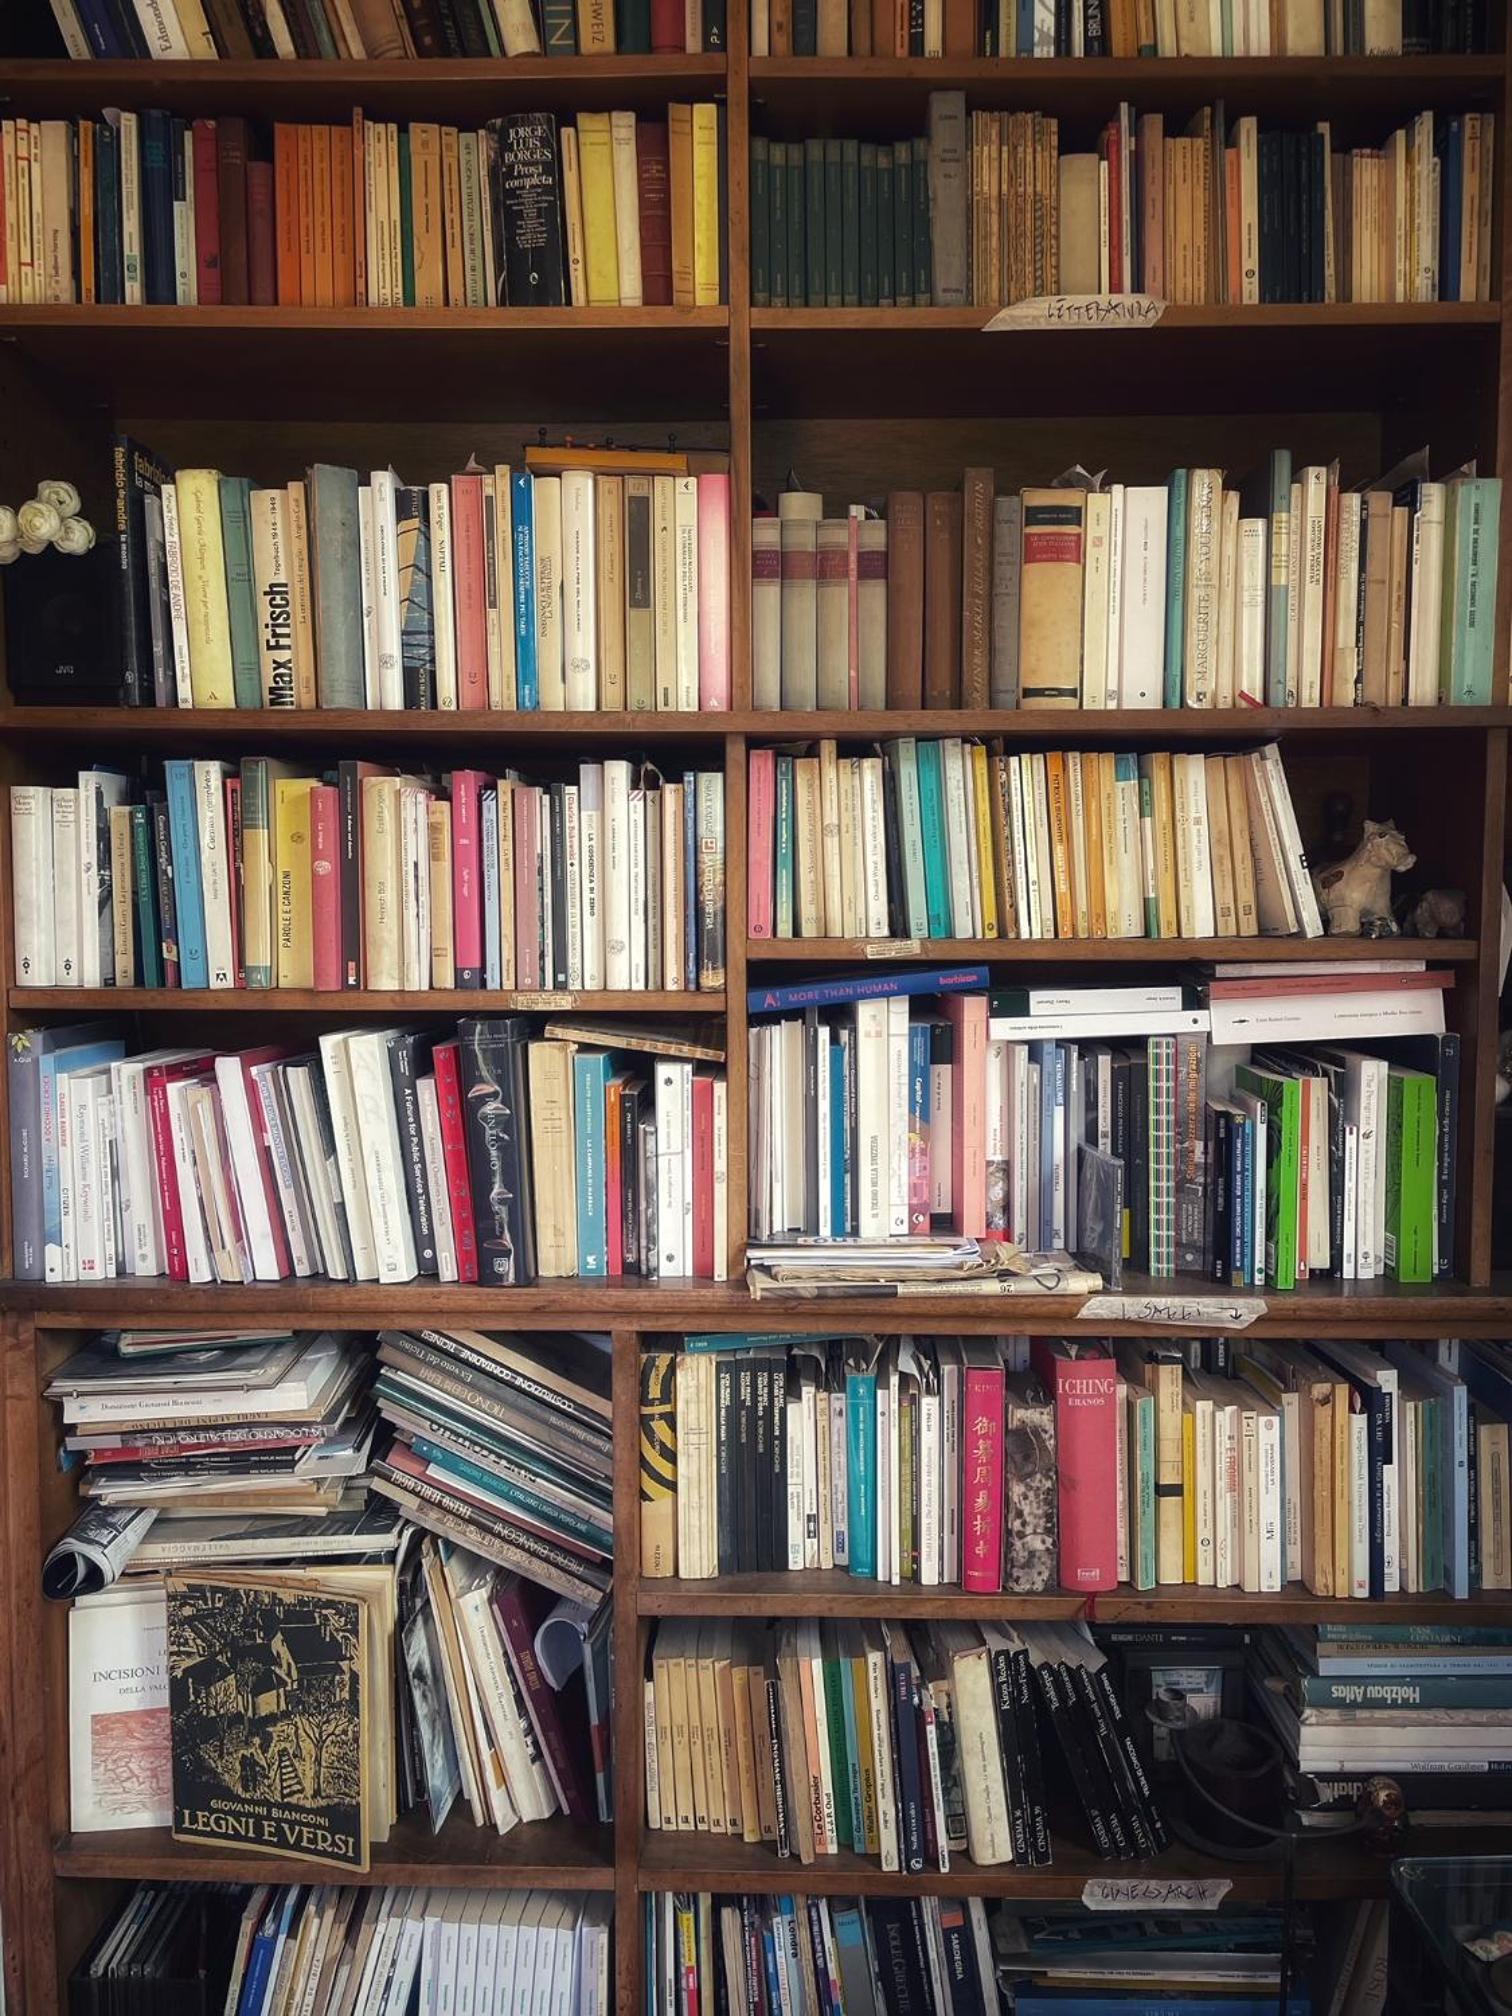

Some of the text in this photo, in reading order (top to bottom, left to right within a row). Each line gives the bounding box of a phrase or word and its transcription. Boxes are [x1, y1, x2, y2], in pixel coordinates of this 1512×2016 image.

[508, 125, 546, 143] JORGE
[513, 139, 541, 151] LUIS
[504, 148, 552, 164] BORGES
[513, 163, 544, 176] Prosa
[504, 175, 553, 189] completa
[115, 446, 127, 487] fabrizio
[974, 480, 984, 529] RODIN
[168, 540, 179, 577] FABRIZIO
[170, 579, 180, 590] DE
[1195, 481, 1212, 683] MARGUERITE YOURCENAR
[1469, 580, 1478, 608] SECONDO
[264, 542, 294, 707] Max Frisch Tagebuch
[1468, 610, 1477, 628] SESSO
[203, 770, 215, 814] completos
[376, 788, 386, 834] Erzählungen
[567, 796, 576, 860] Charles Bukowski
[588, 832, 595, 842] LA
[281, 870, 291, 907] CANZONI
[704, 902, 714, 930] PIETRA
[282, 917, 291, 948] PAROLE
[788, 974, 977, 1003] MORE THAN HUMAN barbican
[405, 1095, 416, 1123] Future
[1186, 1043, 1198, 1179] Storia delle migrazioni
[1363, 1074, 1375, 1126] The Peregrine
[409, 1123, 417, 1135] for
[485, 1097, 499, 1169] JOHN FLORIO
[77, 1104, 92, 1222] Raymond Williams Keywords
[411, 1136, 420, 1162] Public
[413, 1163, 424, 1192] Service
[429, 1135, 445, 1227] Amusing Ourselves Death
[870, 1135, 879, 1211] TICINO NELLA SVIZZERA
[62, 1187, 70, 1217] CITIZEN
[416, 1193, 429, 1235] Television
[422, 1330, 575, 1412] TICINESI CONTADINE COSTRUZIONI
[400, 1340, 425, 1361] Ticino
[426, 1354, 438, 1368] del
[440, 1362, 463, 1377] voto
[464, 1372, 473, 1383] Ex
[549, 1416, 585, 1440] Bianconi
[1066, 1377, 1116, 1395] CHING
[170, 1398, 203, 1408] Bianconi
[469, 1392, 505, 1418] TICINO
[1067, 1397, 1106, 1406] ERANOS
[130, 1420, 167, 1430] TICINO
[195, 1414, 232, 1424] ALPINI
[248, 1427, 310, 1440] LOCARNO
[311, 1427, 327, 1437] LA
[151, 1435, 177, 1446] IERI
[1225, 1454, 1237, 1493] FROMM
[390, 1472, 585, 1574] OGGI IERI TICINO BIANCONI PIERO
[160, 1543, 231, 1553] VALLEMAGGIA
[1409, 1626, 1430, 1635] CASE
[92, 1664, 162, 1684] INCISIONI
[871, 1674, 879, 1699] Wenders
[118, 1685, 145, 1696] DELLA
[1331, 1685, 1421, 1705] Holzbau Atlas
[996, 1655, 1025, 1853] CINEMA Reden
[1017, 1655, 1047, 1852] CINEMA Non-Fiction
[1409, 1762, 1447, 1772] Wolfram
[771, 1739, 785, 1836] INGMAR BERGMAN
[1095, 1717, 1147, 1849] CINEMA Hier
[811, 1775, 823, 1836] Le Corbusier
[824, 1792, 832, 1810] Oud
[850, 1762, 862, 1834] Giuseppe Terragni
[863, 1768, 875, 1834] Walter Gropius
[210, 1799, 330, 1827] GIOVANNI BIANCONI
[181, 1808, 355, 1857] LEGNI E VERSI
[1096, 1821, 1110, 1849] CINEMA
[1111, 1813, 1126, 1847] CINEMA
[787, 1919, 797, 1959] Londra
[950, 1931, 965, 1980] SARDEGNA
